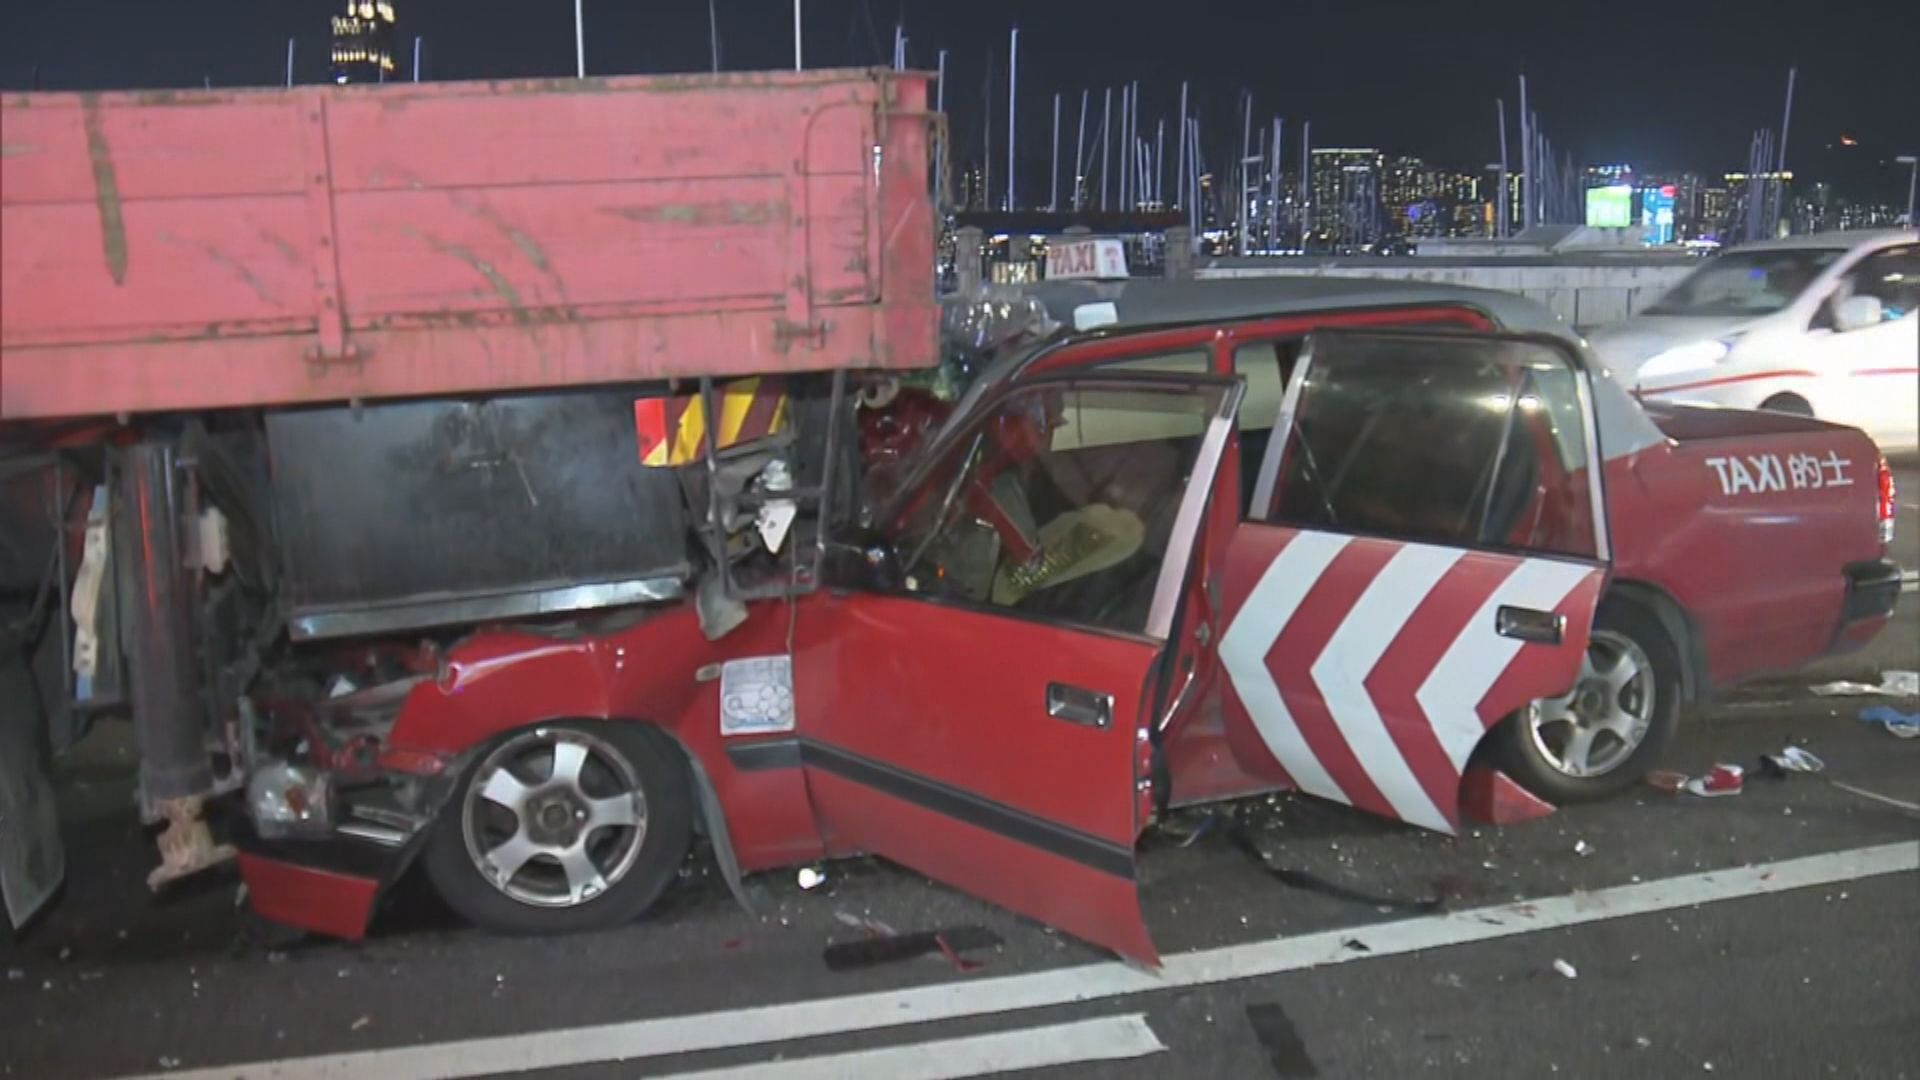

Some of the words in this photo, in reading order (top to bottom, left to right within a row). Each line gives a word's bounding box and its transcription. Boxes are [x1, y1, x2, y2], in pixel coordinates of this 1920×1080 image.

[1049, 242, 1096, 276] TAXI
[1705, 453, 1786, 494] TAXI
[1787, 450, 1854, 488] 的士
